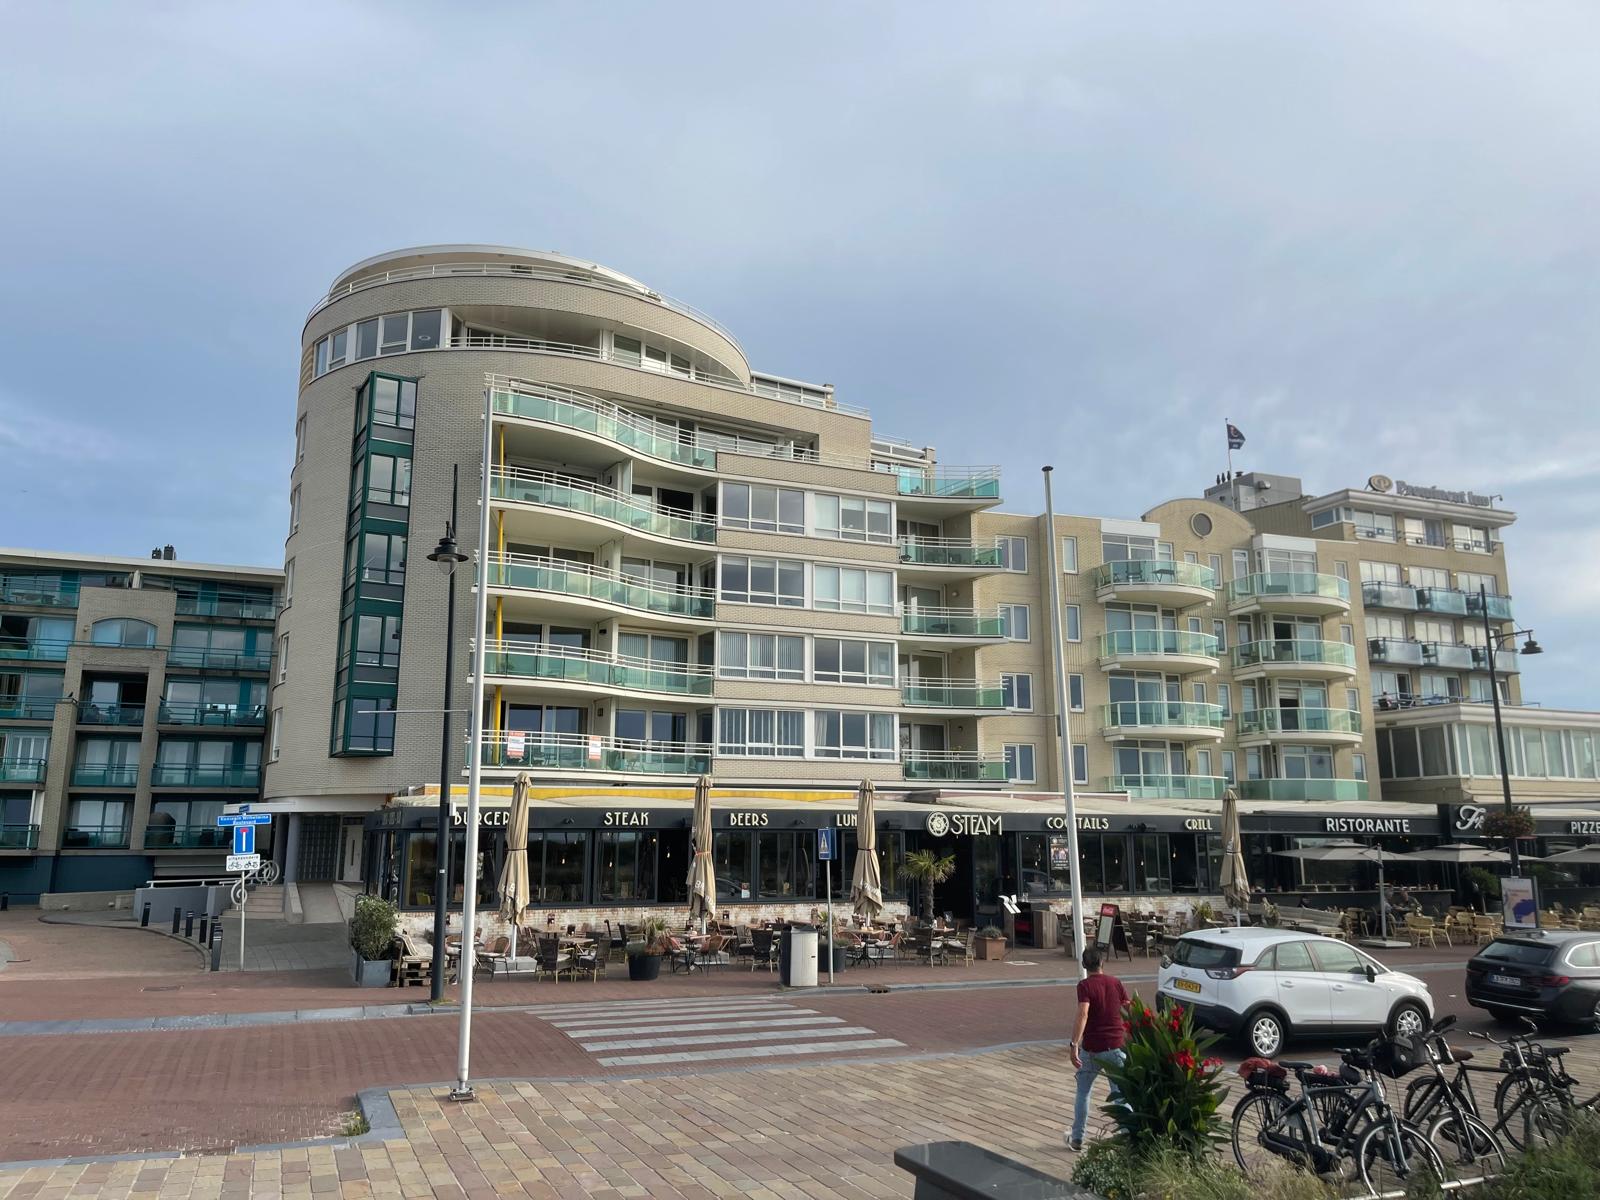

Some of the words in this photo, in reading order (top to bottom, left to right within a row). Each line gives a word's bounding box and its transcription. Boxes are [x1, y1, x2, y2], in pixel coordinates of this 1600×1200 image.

[604, 812, 650, 826] STEAK
[730, 813, 768, 826] BEERS
[951, 814, 1002, 836] STEAM
[1047, 817, 1109, 830] COTAILS
[1325, 817, 1411, 833] RISTORANTE
